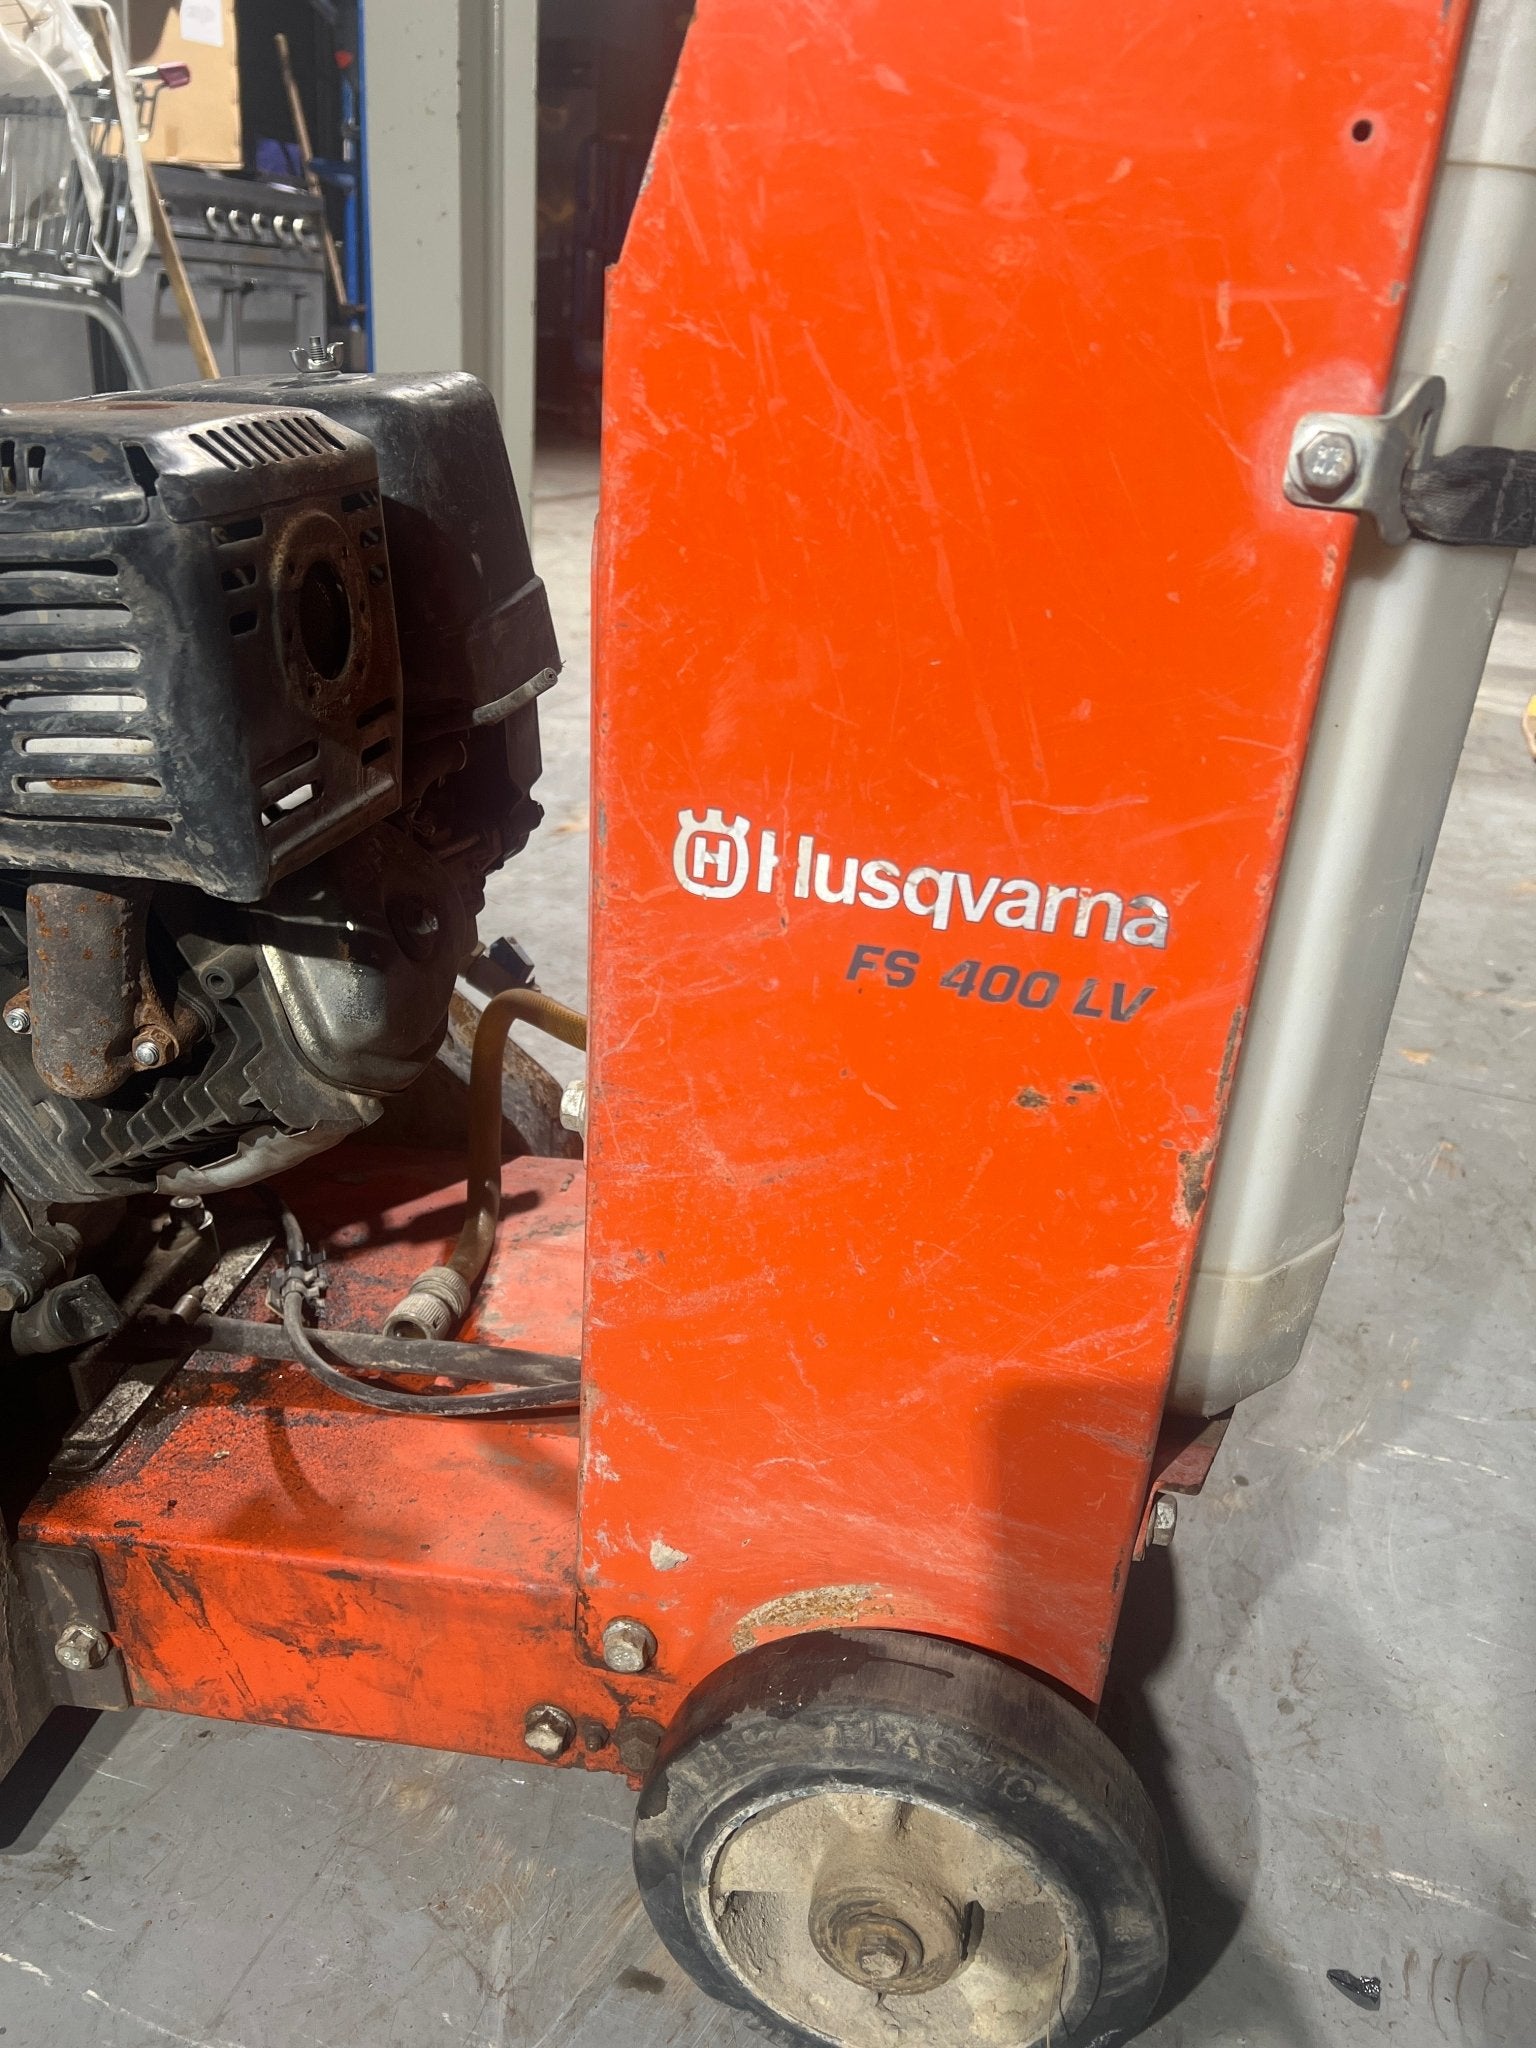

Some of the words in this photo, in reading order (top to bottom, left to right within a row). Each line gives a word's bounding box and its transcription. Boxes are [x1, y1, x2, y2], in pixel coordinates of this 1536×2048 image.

[757, 831, 1171, 949] Husqvarna
[847, 945, 919, 987] FS
[940, 960, 1060, 1010] 400
[1073, 978, 1155, 1023] LV
